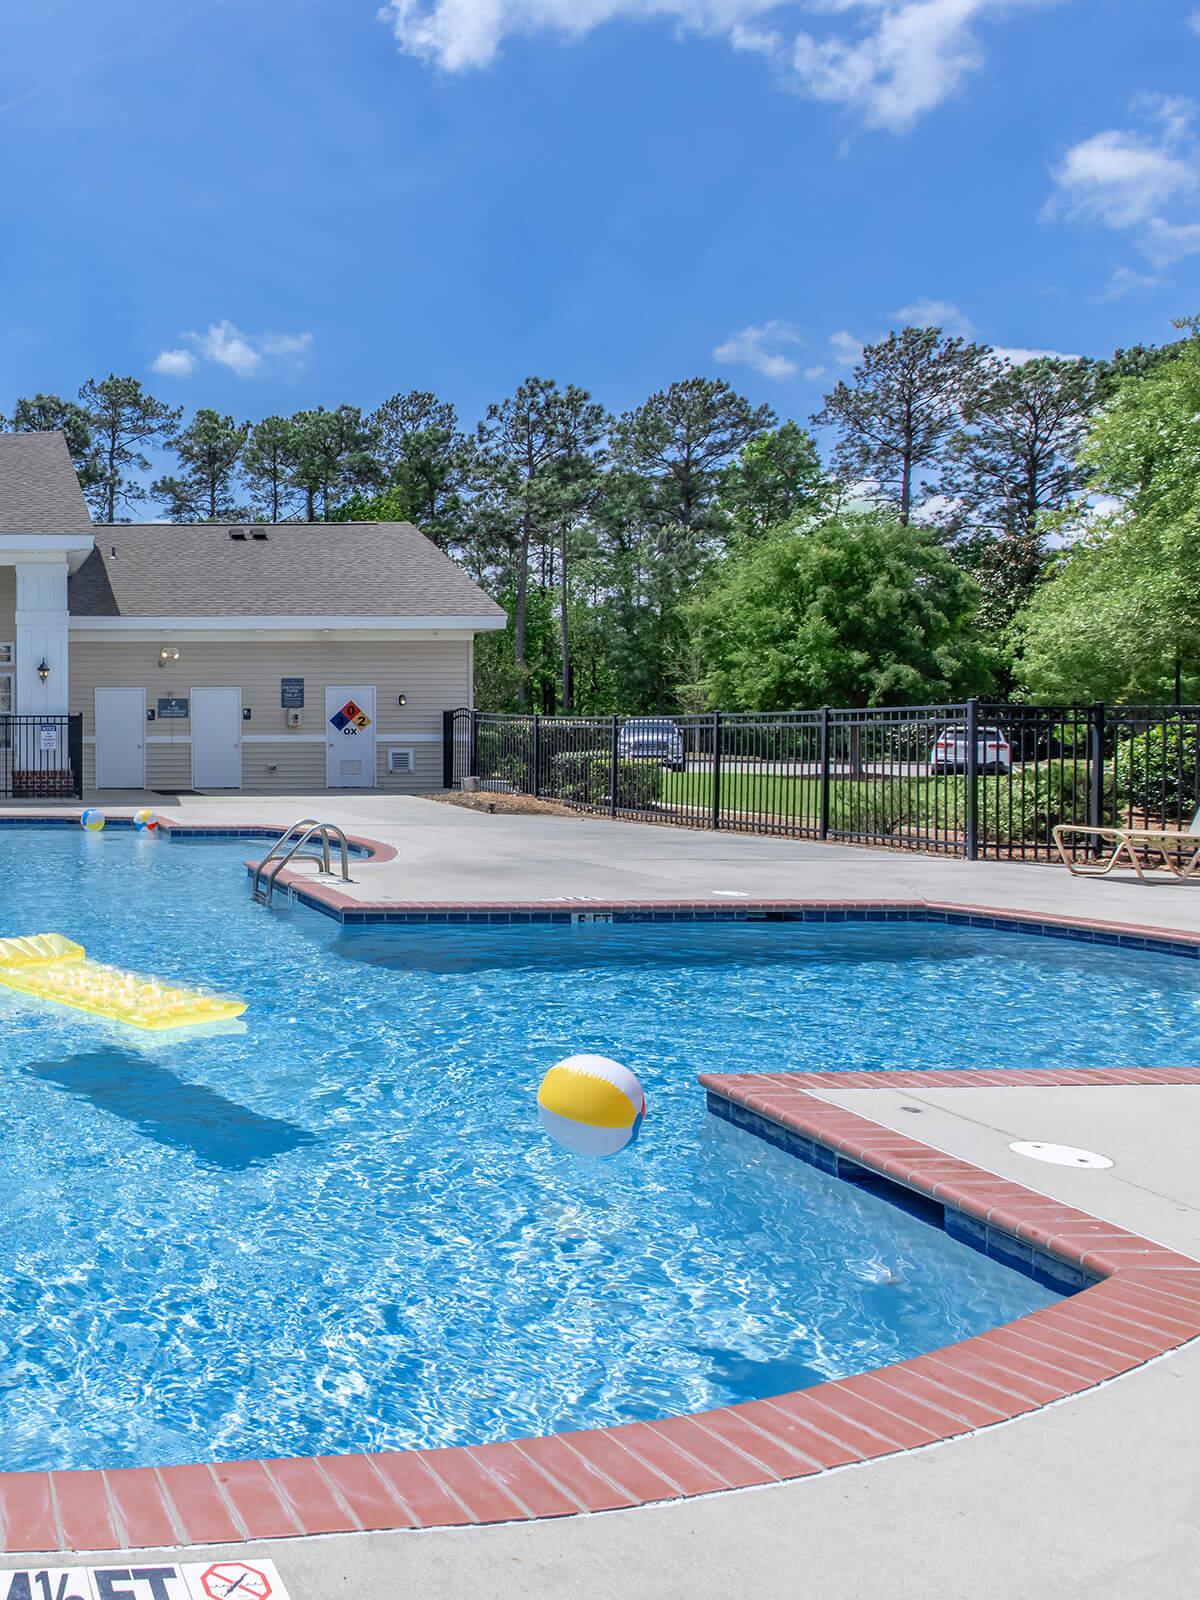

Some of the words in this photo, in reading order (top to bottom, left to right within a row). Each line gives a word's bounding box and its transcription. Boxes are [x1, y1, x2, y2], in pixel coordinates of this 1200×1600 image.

[347, 705, 355, 716] 0
[358, 716, 366, 726] 2
[94, 1567, 178, 1600] FT
